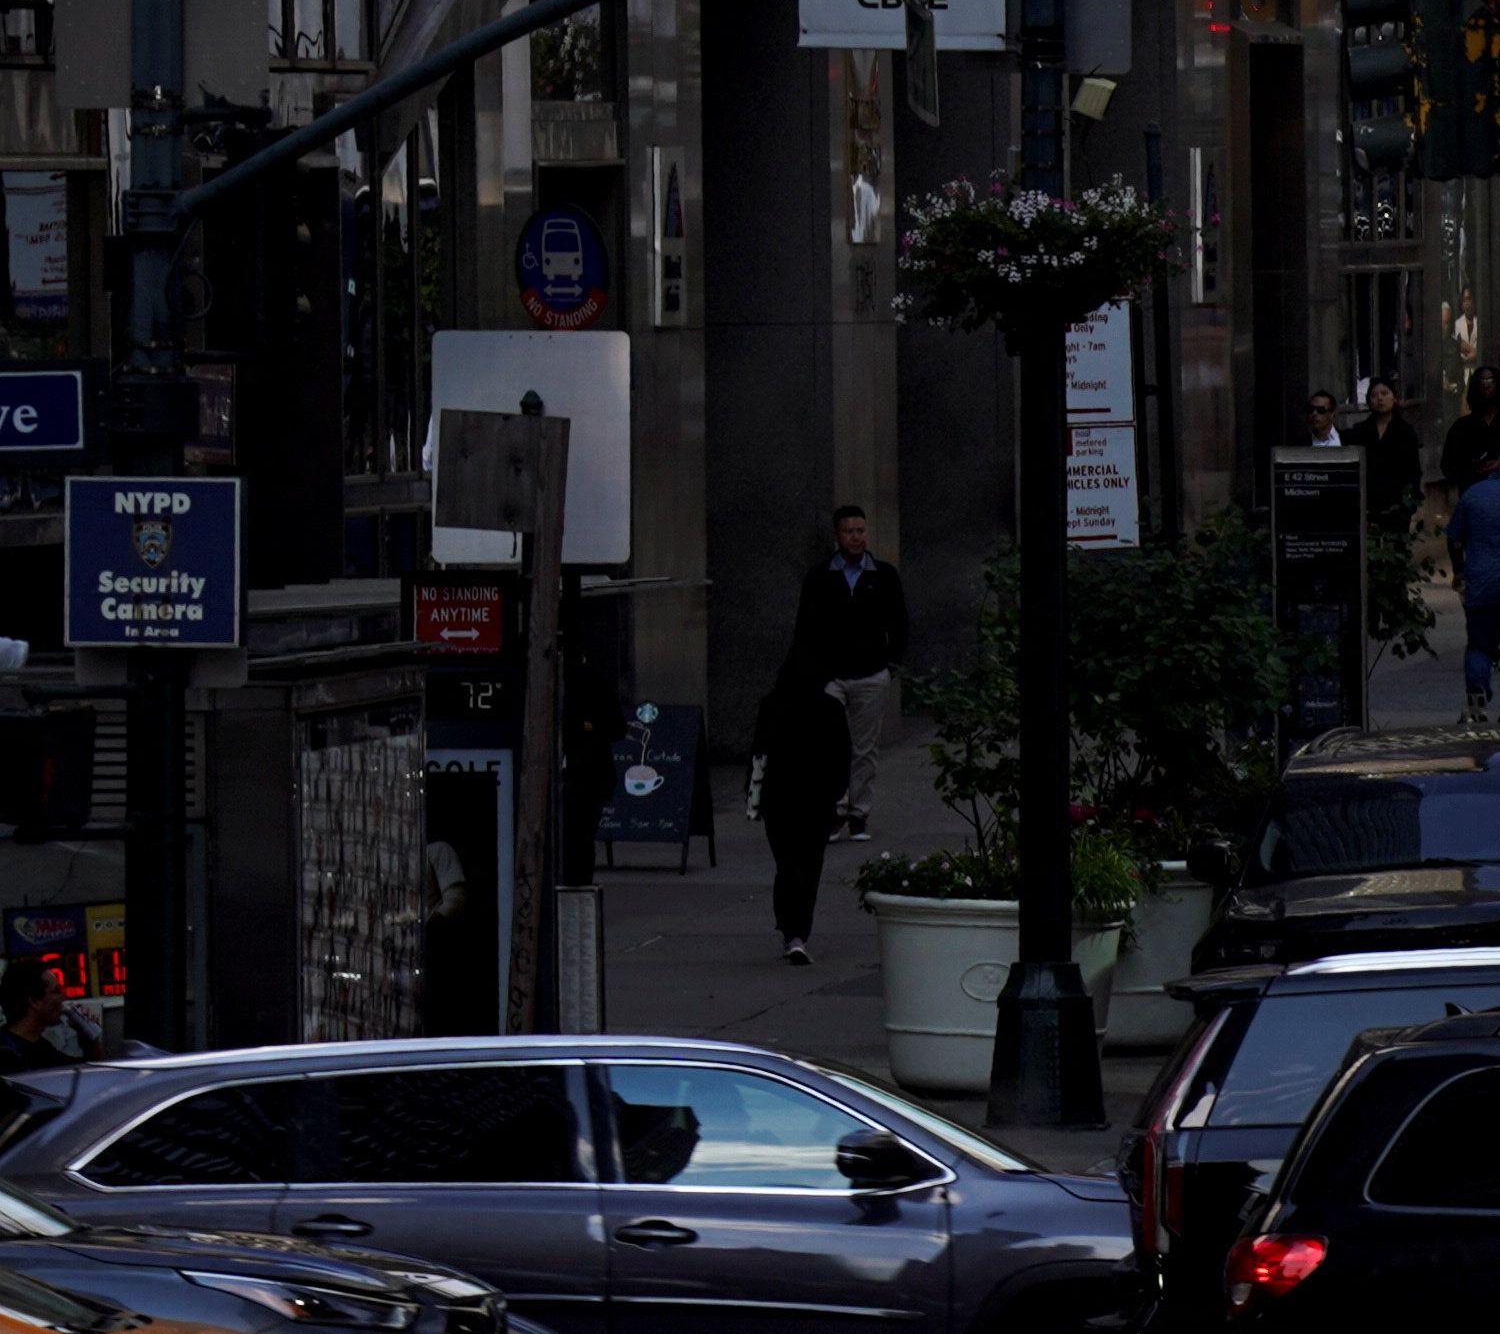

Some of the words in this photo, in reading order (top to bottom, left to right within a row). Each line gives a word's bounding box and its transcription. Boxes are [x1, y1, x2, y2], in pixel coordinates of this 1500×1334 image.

[525, 295, 543, 317] NO
[544, 297, 598, 328] STANDING
[1073, 323, 1095, 335] Only
[1088, 341, 1106, 352] 7am
[1071, 379, 1108, 393] Midnight
[1074, 438, 1108, 447] metered
[1075, 447, 1104, 458] parking
[1102, 476, 1130, 489] ONLY
[113, 490, 192, 515] NYPD
[1075, 505, 1110, 519] Midnight
[1083, 517, 1116, 531] Sunday
[97, 570, 206, 599] Security
[421, 586, 437, 602] NO
[442, 584, 500, 602] STANDING
[100, 597, 203, 620] Camera
[429, 606, 491, 624] ANYTIME
[125, 625, 138, 638] In
[143, 625, 180, 638] Area
